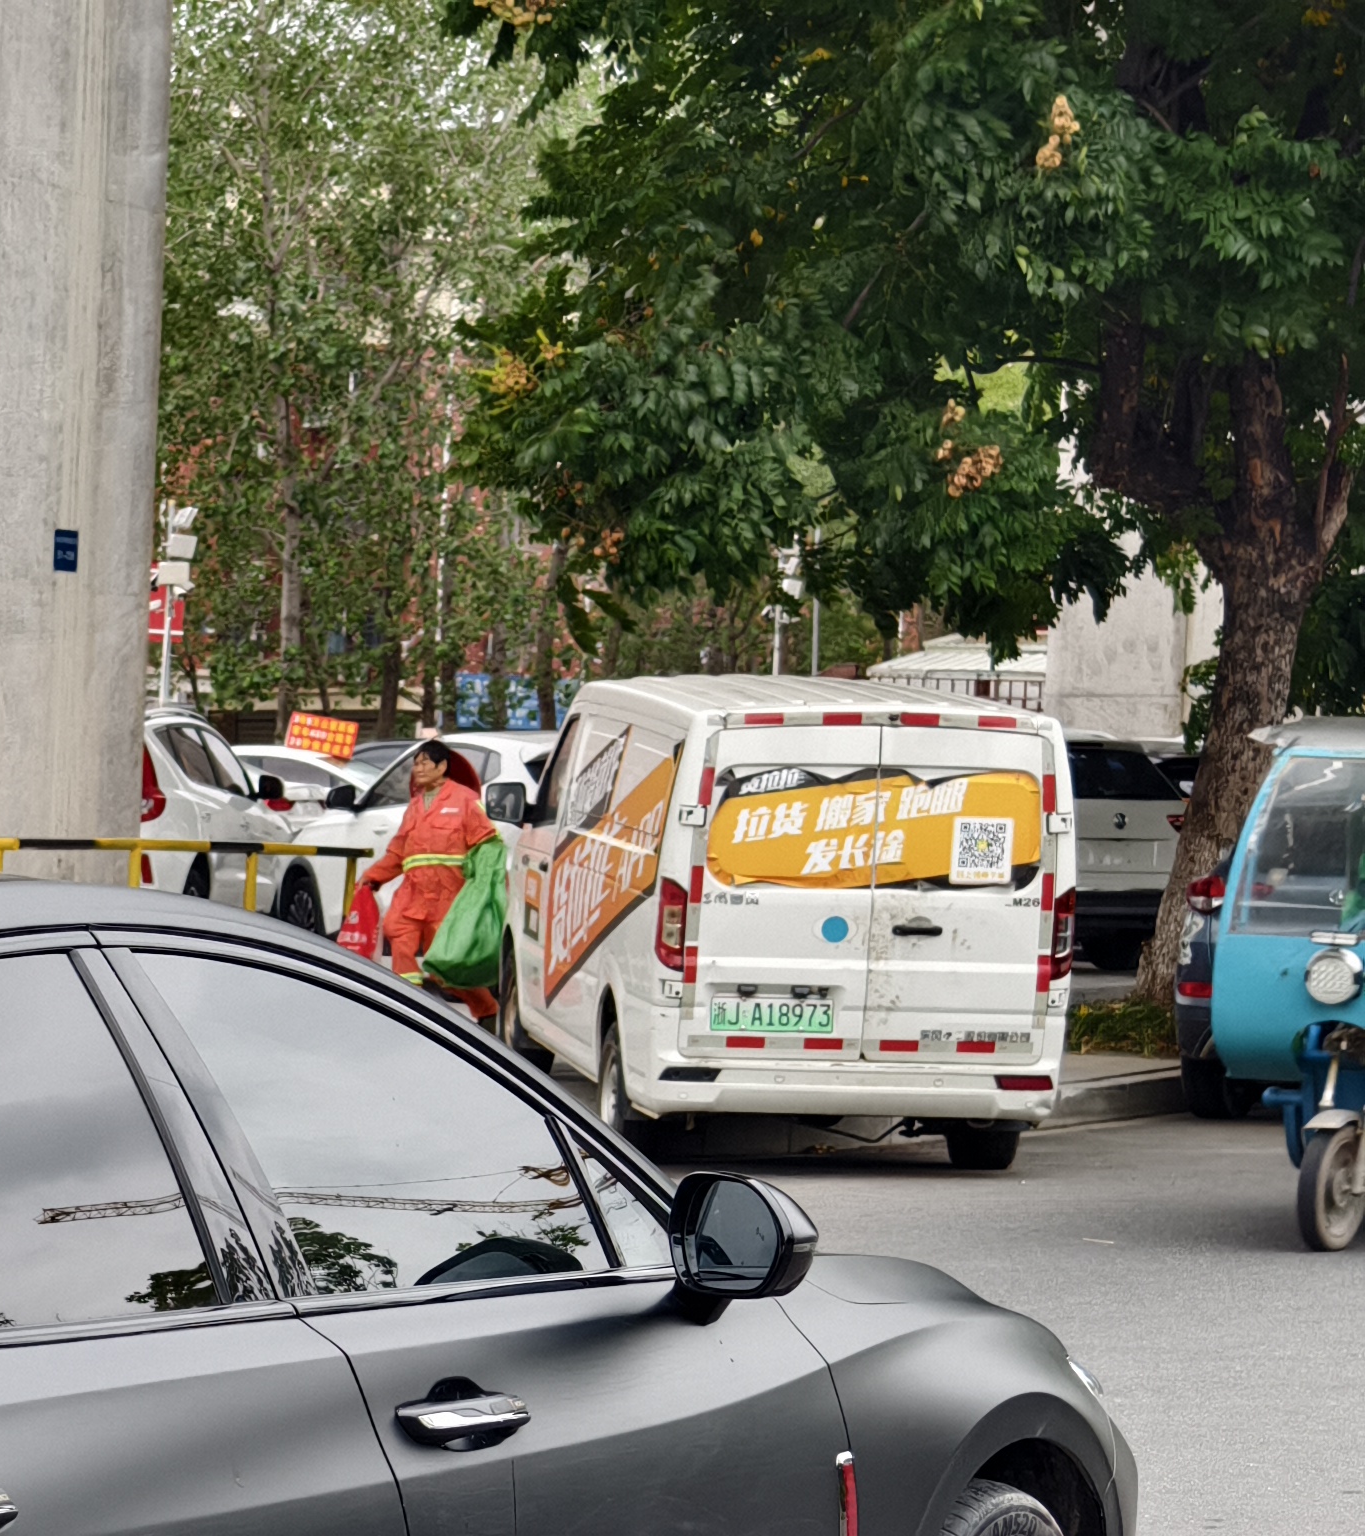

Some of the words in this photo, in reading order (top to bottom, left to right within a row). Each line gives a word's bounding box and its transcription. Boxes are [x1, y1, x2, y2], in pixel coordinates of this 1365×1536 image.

[731, 801, 810, 844] 拉货
[814, 790, 892, 832] 搬家
[896, 778, 968, 821] 跑腿
[800, 829, 905, 876] 发长途
